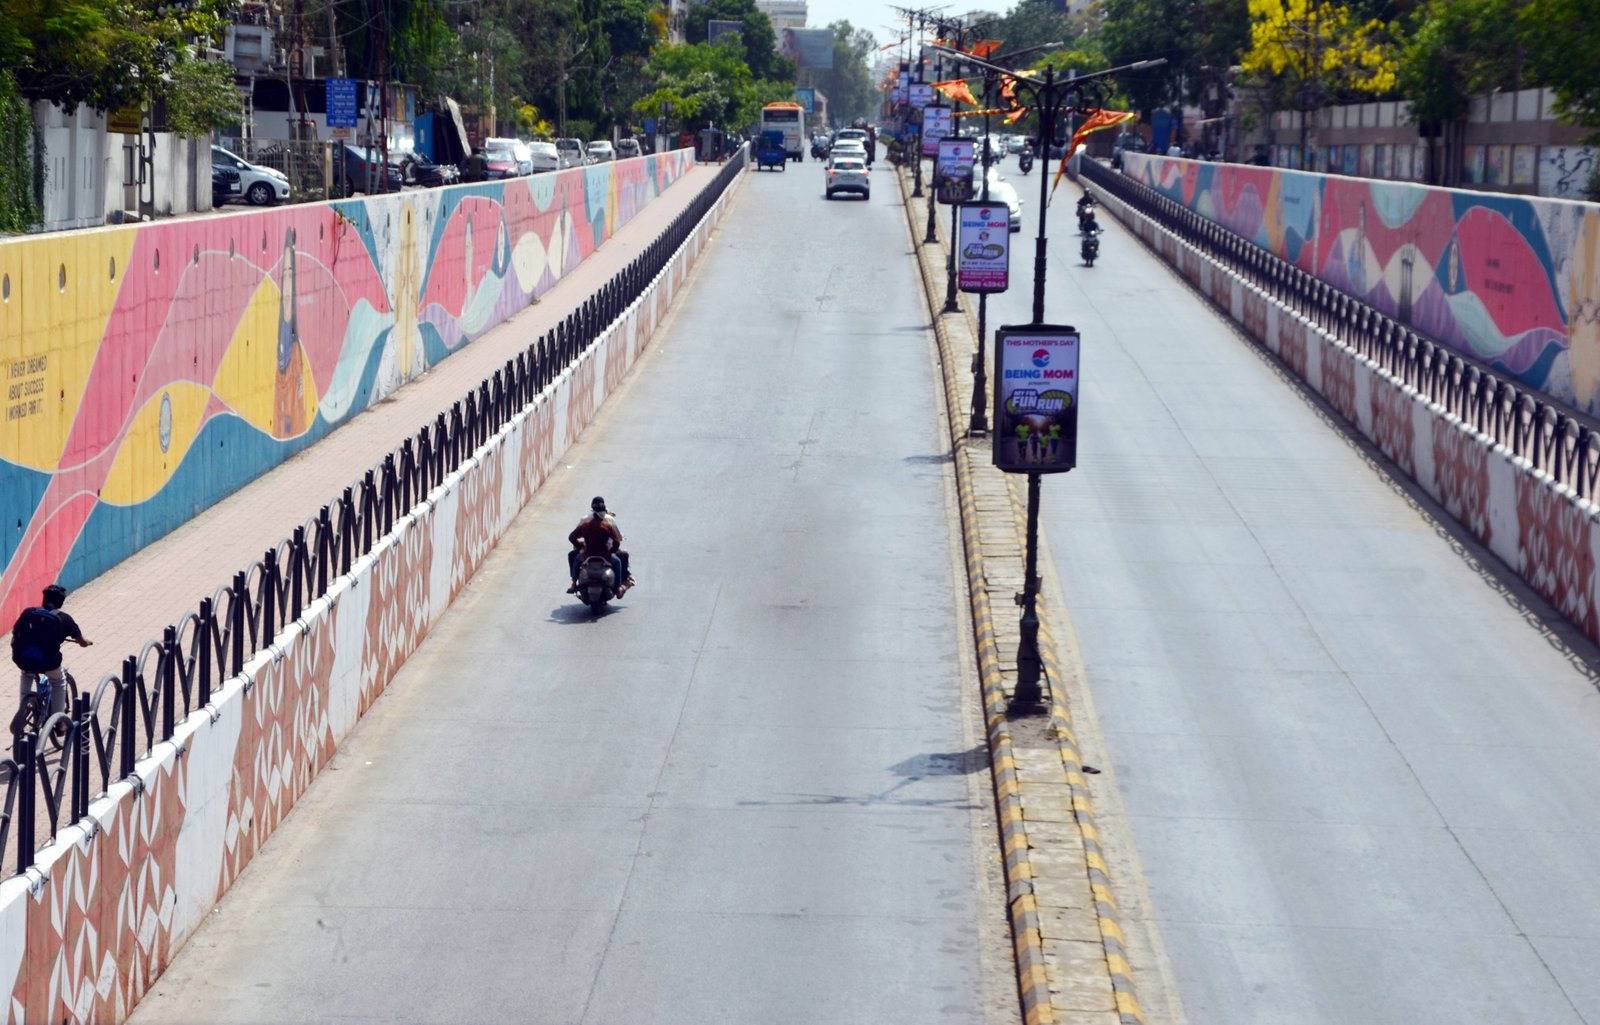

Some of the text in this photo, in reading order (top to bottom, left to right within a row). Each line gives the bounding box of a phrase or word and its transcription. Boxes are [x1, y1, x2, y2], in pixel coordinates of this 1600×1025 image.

[1005, 369, 1073, 379] BEING MOM
[1012, 396, 1063, 410] FUN RUN
